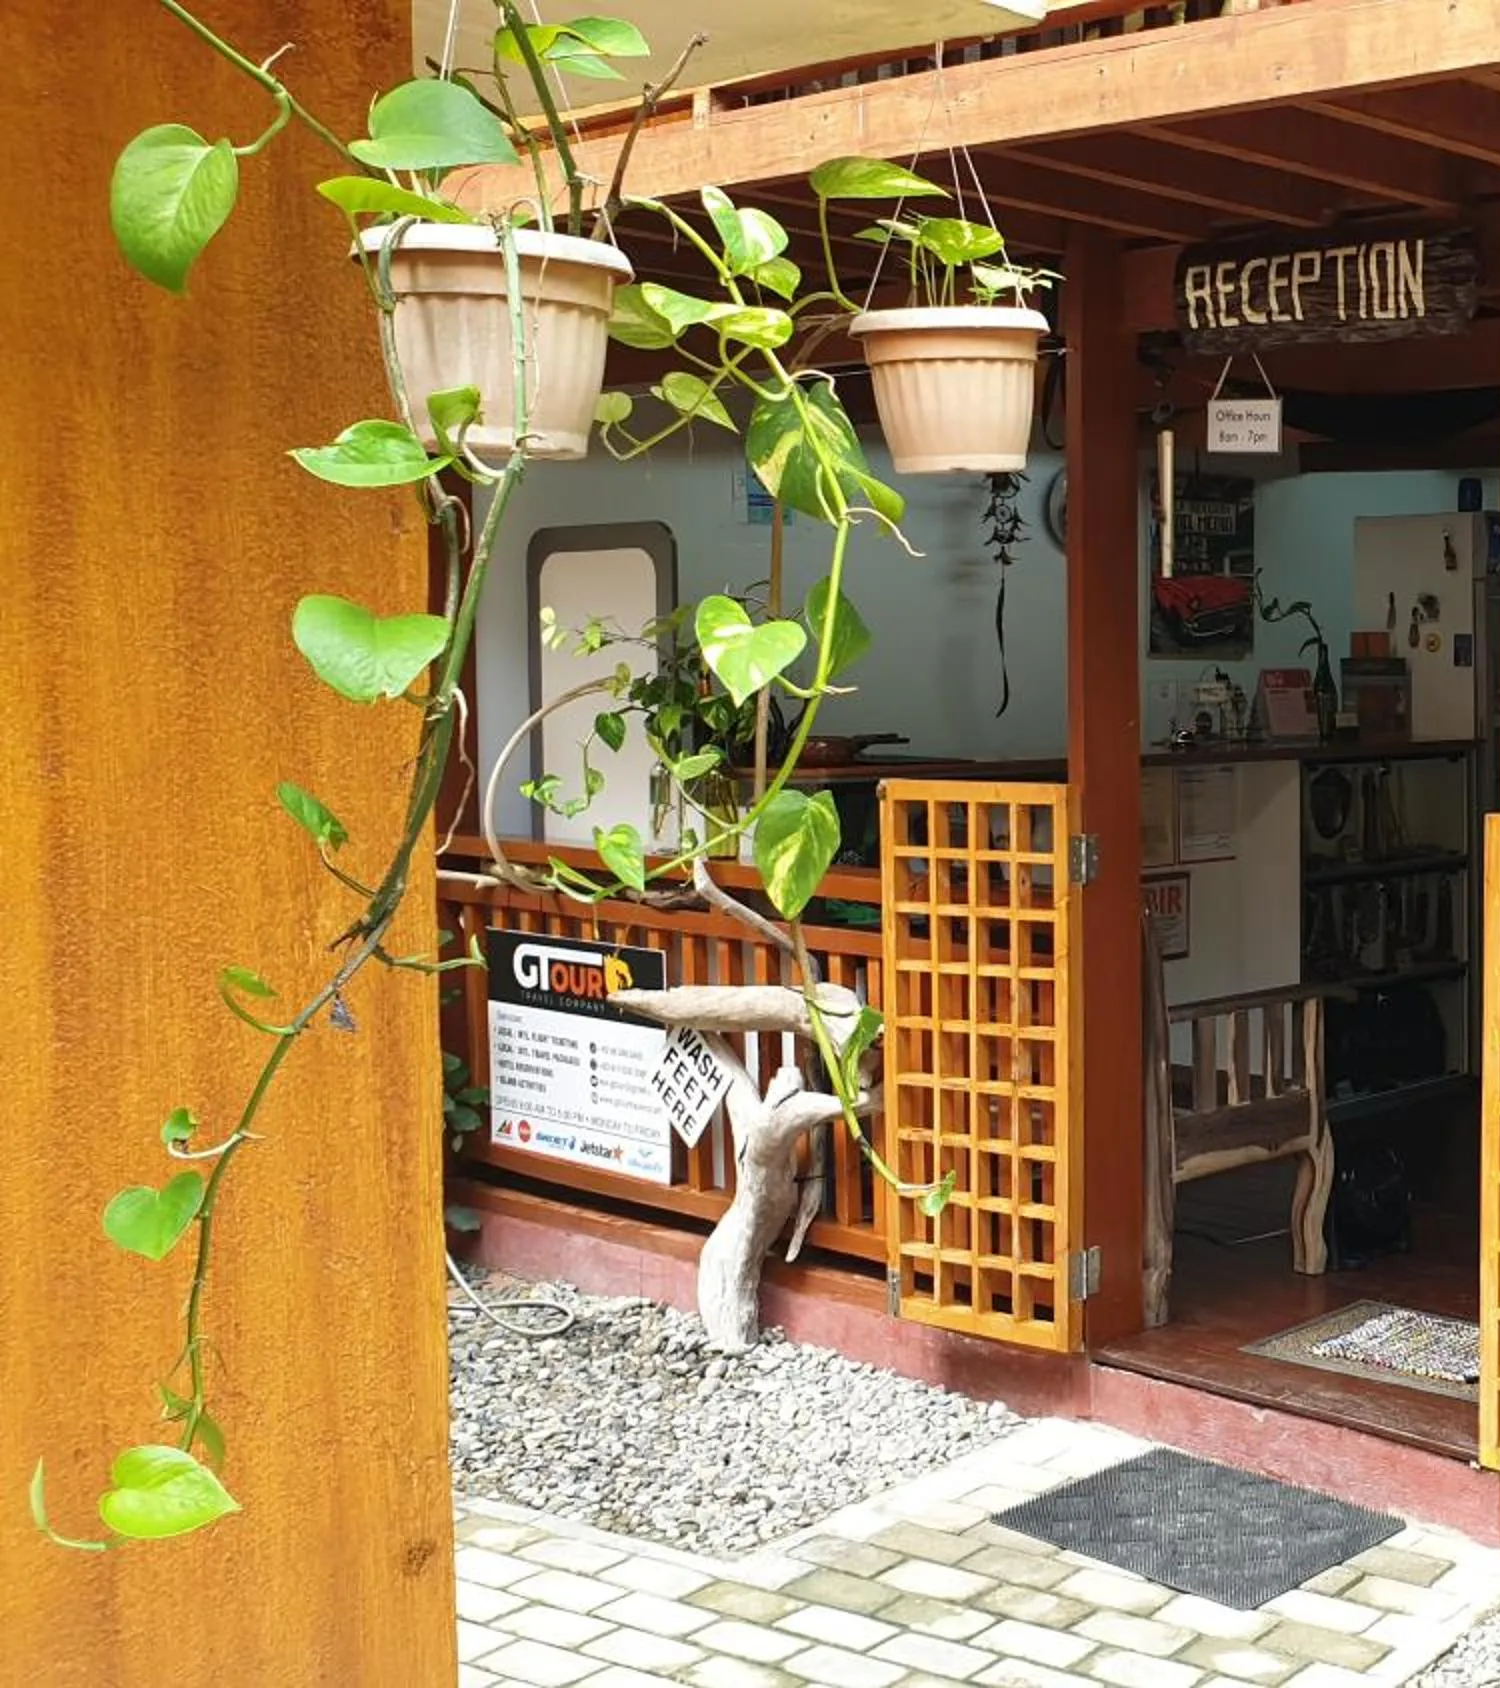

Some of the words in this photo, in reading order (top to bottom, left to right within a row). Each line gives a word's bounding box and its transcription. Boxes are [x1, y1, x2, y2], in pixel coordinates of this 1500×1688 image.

[1185, 239, 1425, 329] RECEPTION
[1216, 409, 1243, 422] Office
[1245, 410, 1271, 422] Hours
[1248, 430, 1268, 444] 7pm
[521, 991, 554, 1006] TRAVEL
[560, 997, 605, 1012] COMPANY
[663, 1046, 711, 1111] FEET
[677, 1026, 724, 1091] WASH
[651, 1070, 697, 1136] HERE
[580, 1141, 613, 1160] Jetstar
